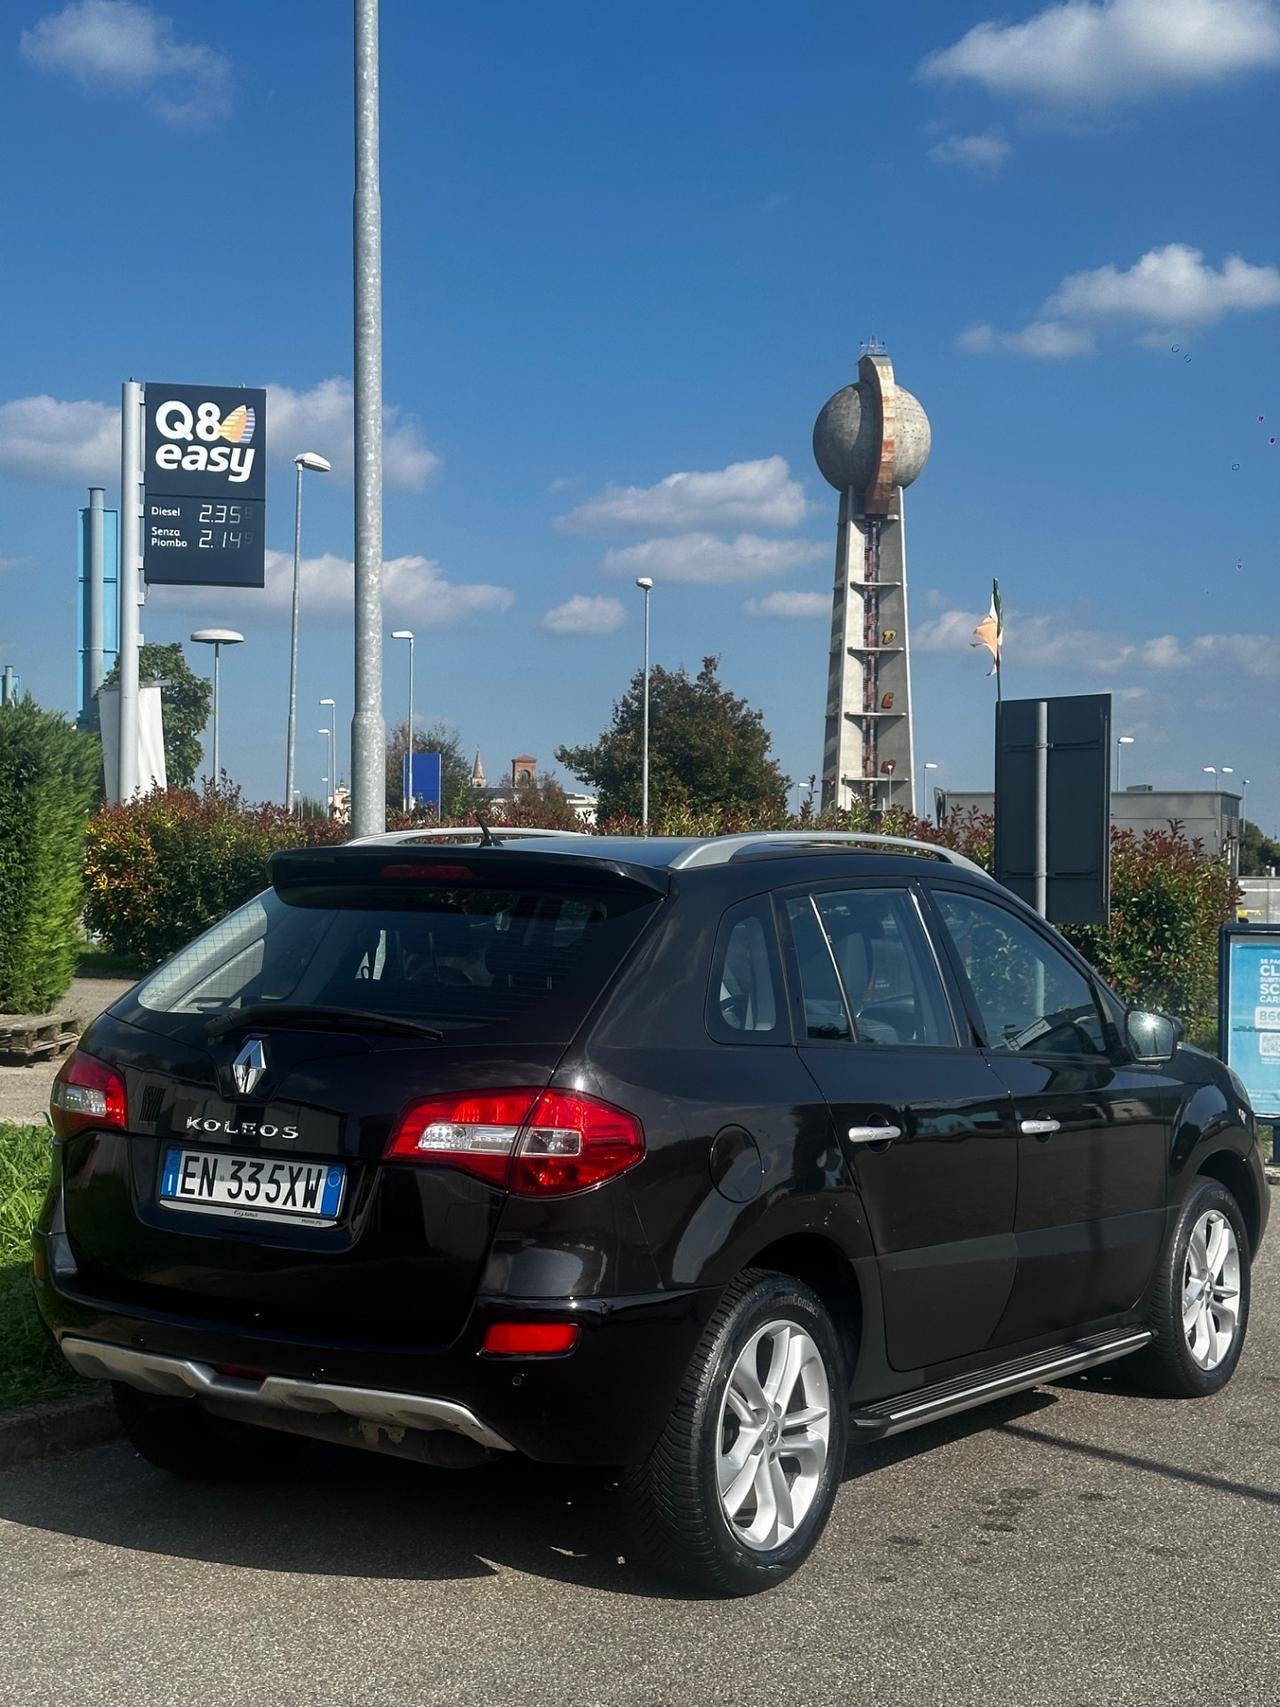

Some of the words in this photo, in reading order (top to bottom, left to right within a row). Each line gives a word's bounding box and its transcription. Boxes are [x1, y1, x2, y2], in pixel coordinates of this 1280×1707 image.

[155, 400, 221, 441] Q8
[155, 443, 255, 482] easy
[151, 506, 181, 516] Diesel
[151, 526, 181, 536] Senza
[151, 537, 188, 547] Piombo
[1260, 983, 1280, 995] SC
[1259, 995, 1280, 1004] CAR
[186, 1116, 299, 1139] KOLEOS
[180, 1155, 218, 1198] EN
[227, 1160, 323, 1209] 335XW
